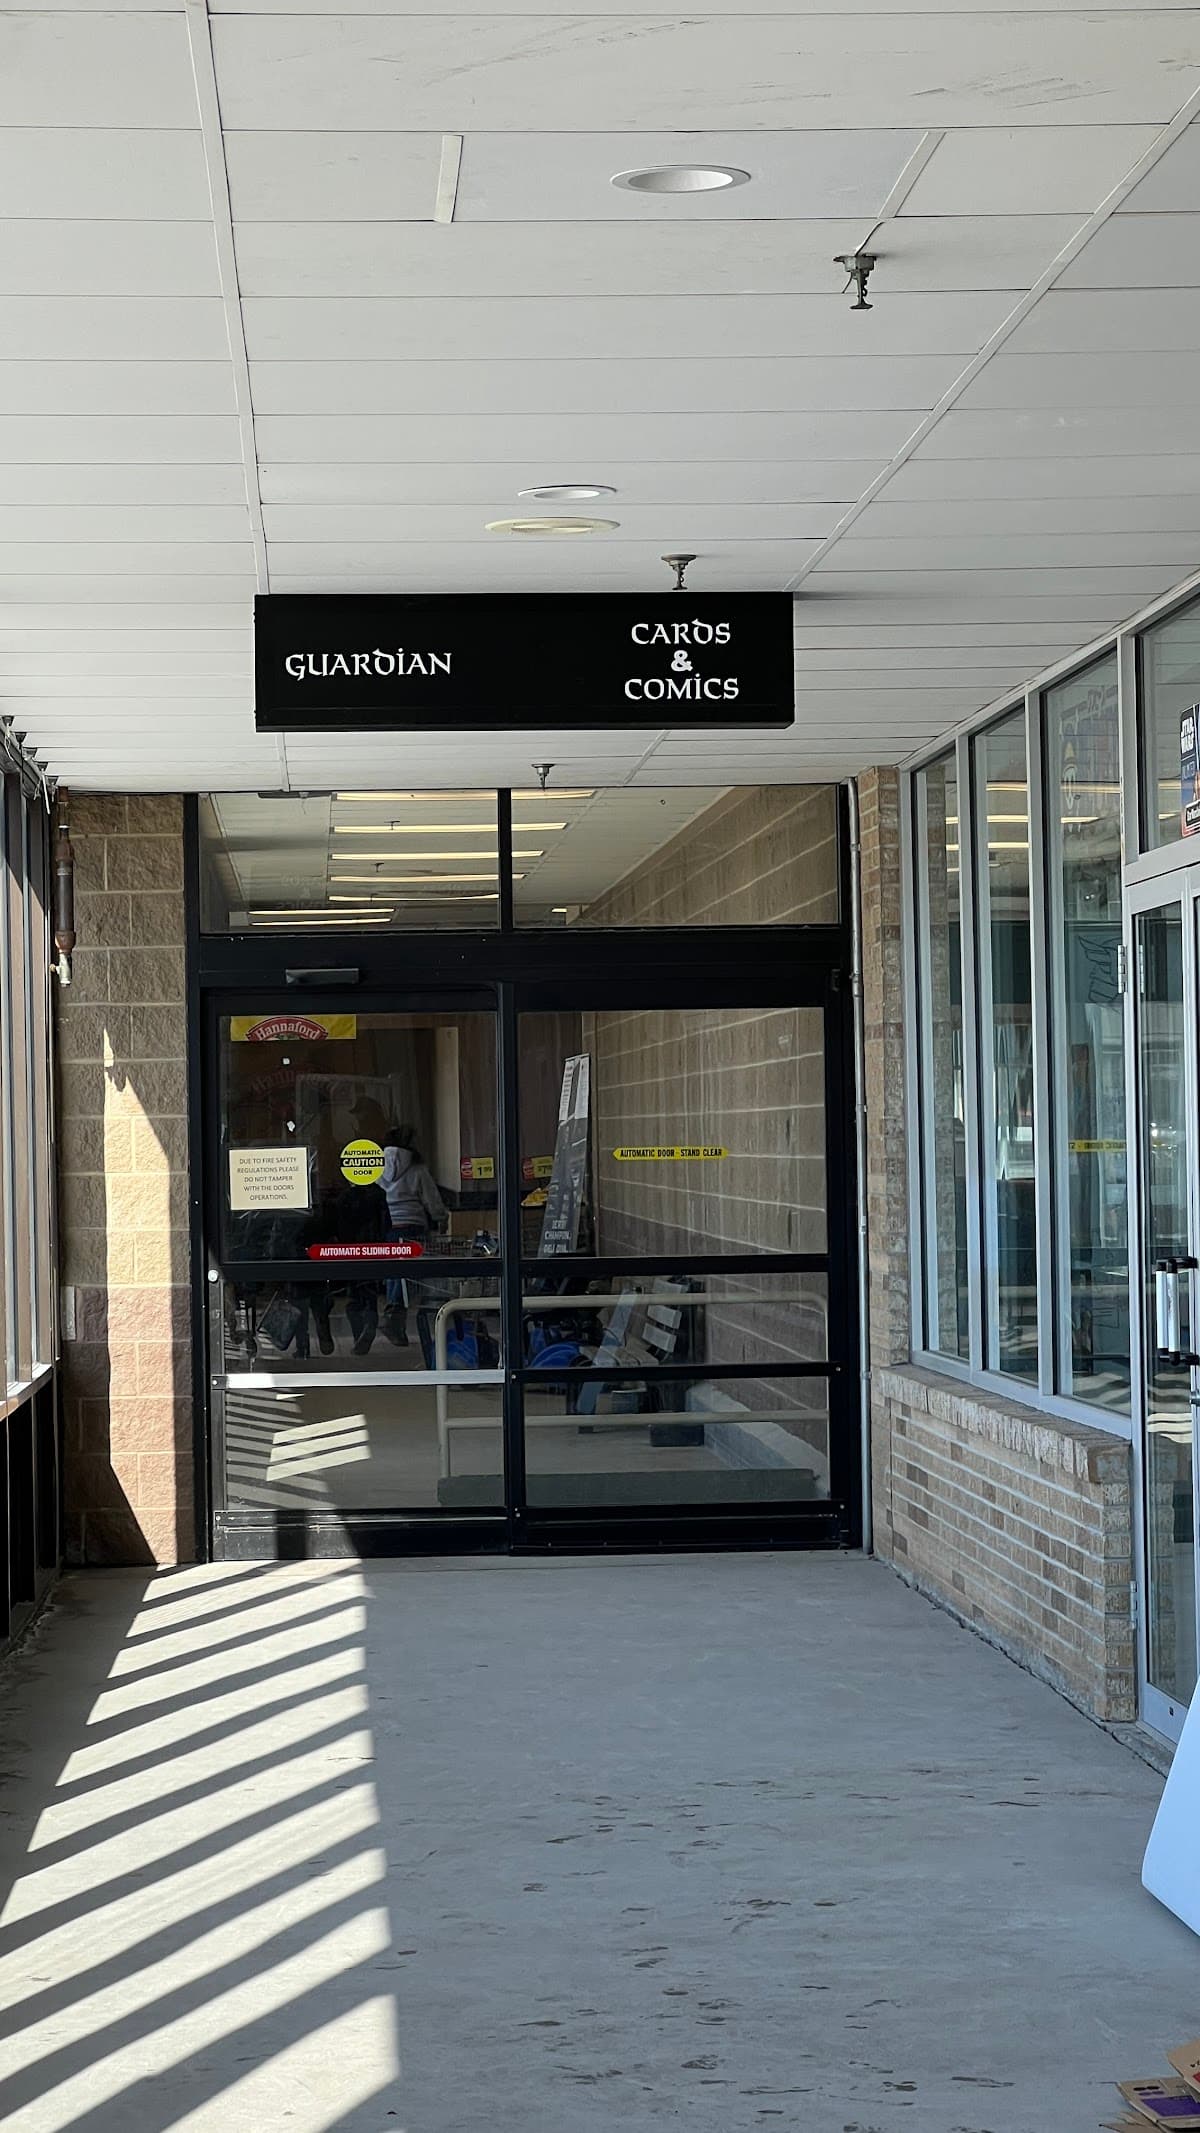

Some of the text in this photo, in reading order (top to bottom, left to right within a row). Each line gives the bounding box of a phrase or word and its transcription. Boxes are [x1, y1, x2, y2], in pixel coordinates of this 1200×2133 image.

[631, 618, 731, 645] CARDS
[285, 647, 452, 681] GUARDIAN
[671, 649, 693, 672] &
[624, 672, 740, 700] COMICS
[254, 1021, 321, 1040] Hannaford
[342, 1158, 384, 1167] CAUTION
[620, 1148, 655, 1158] AUTOMATIC
[657, 1148, 675, 1158] DOOR
[680, 1148, 700, 1157] STAND
[702, 1148, 722, 1157] CLEAR
[319, 1246, 412, 1257] AUTOMATIC SLIDING DOOR
